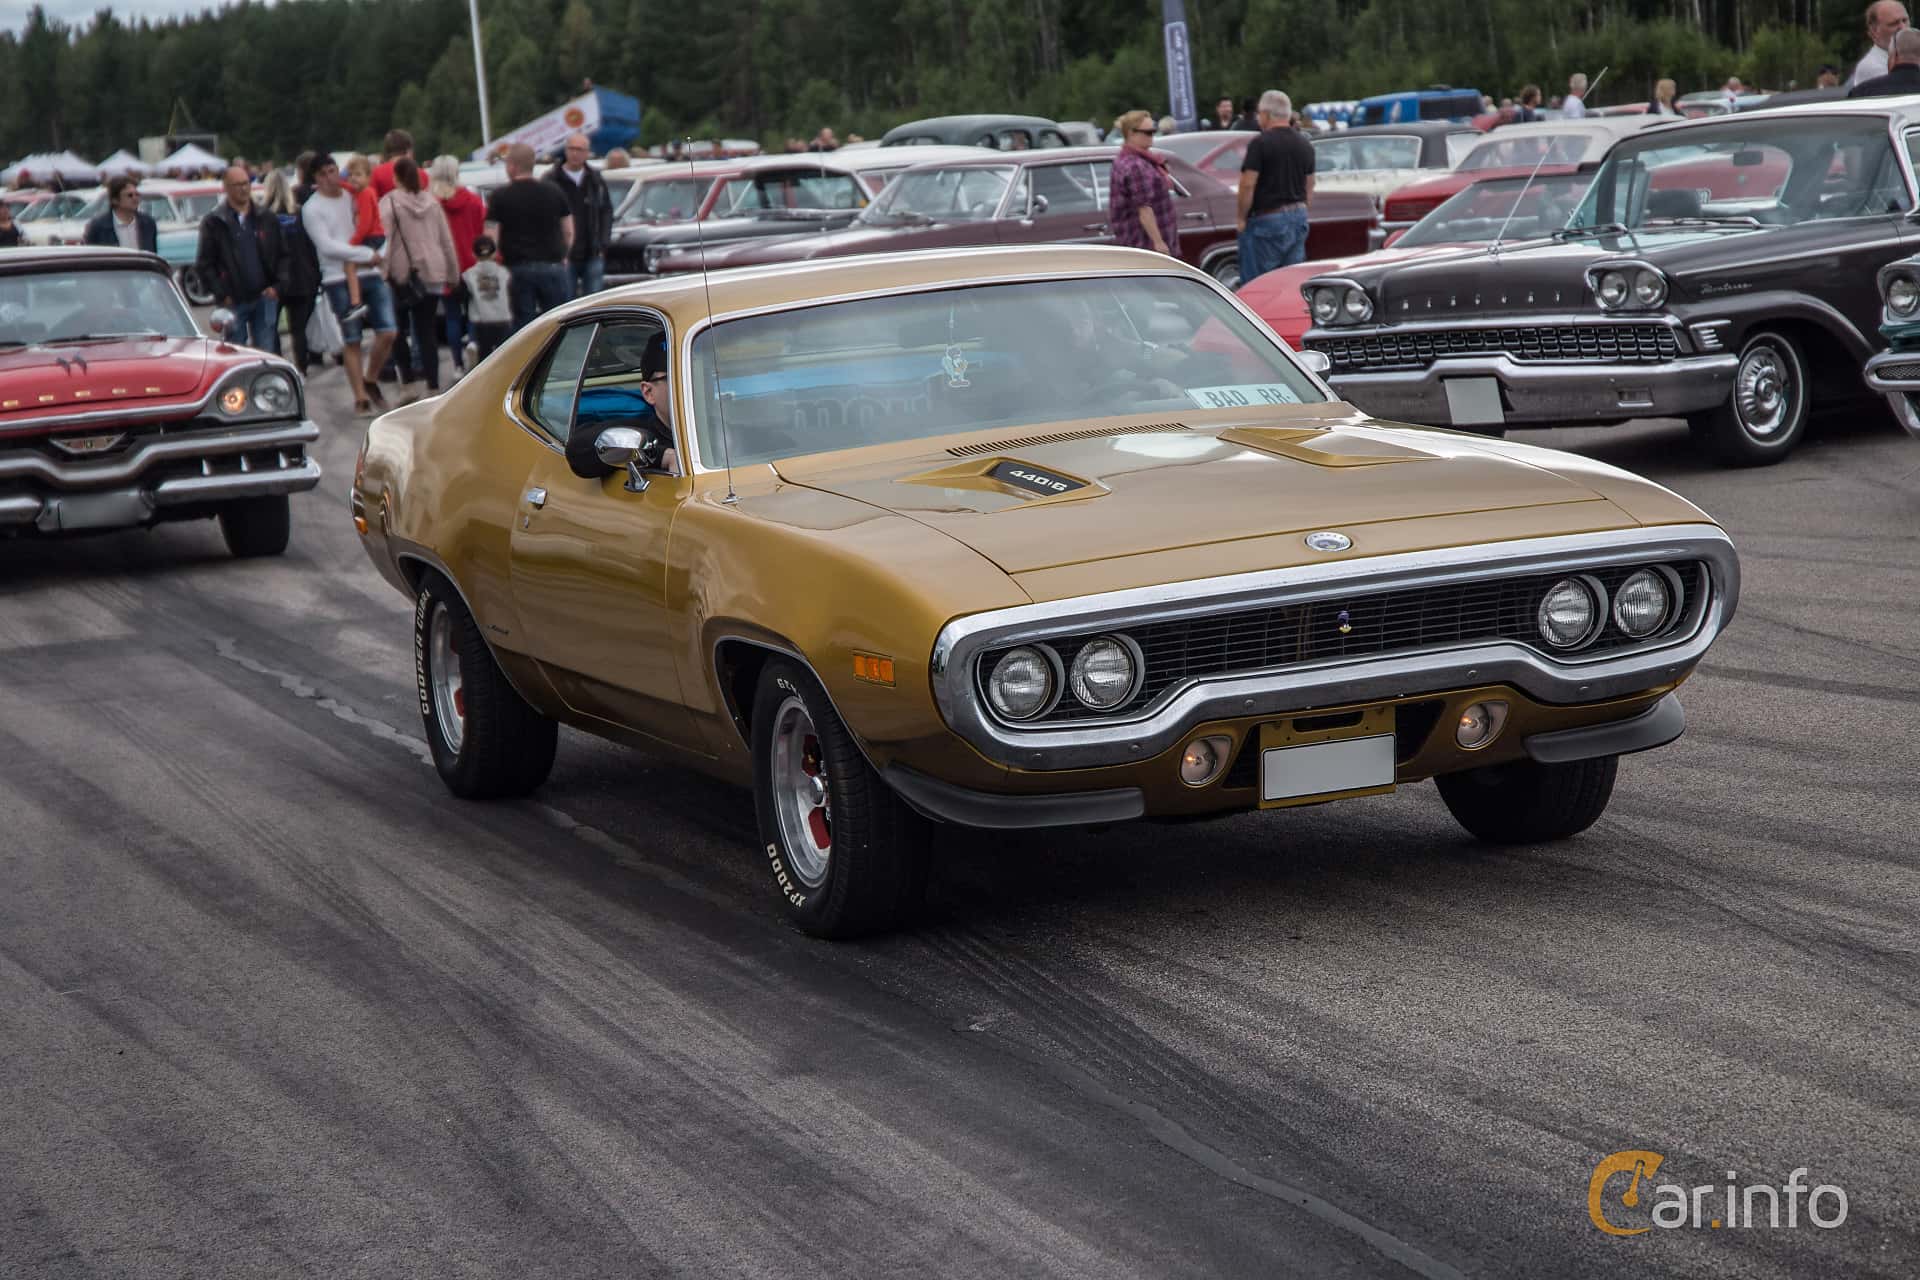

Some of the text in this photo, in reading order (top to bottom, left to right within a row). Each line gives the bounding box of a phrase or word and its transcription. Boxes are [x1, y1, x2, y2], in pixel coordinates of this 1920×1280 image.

[1204, 390, 1249, 407] BAD
[416, 636, 430, 715] COOPER
[766, 843, 807, 907] XP2000
